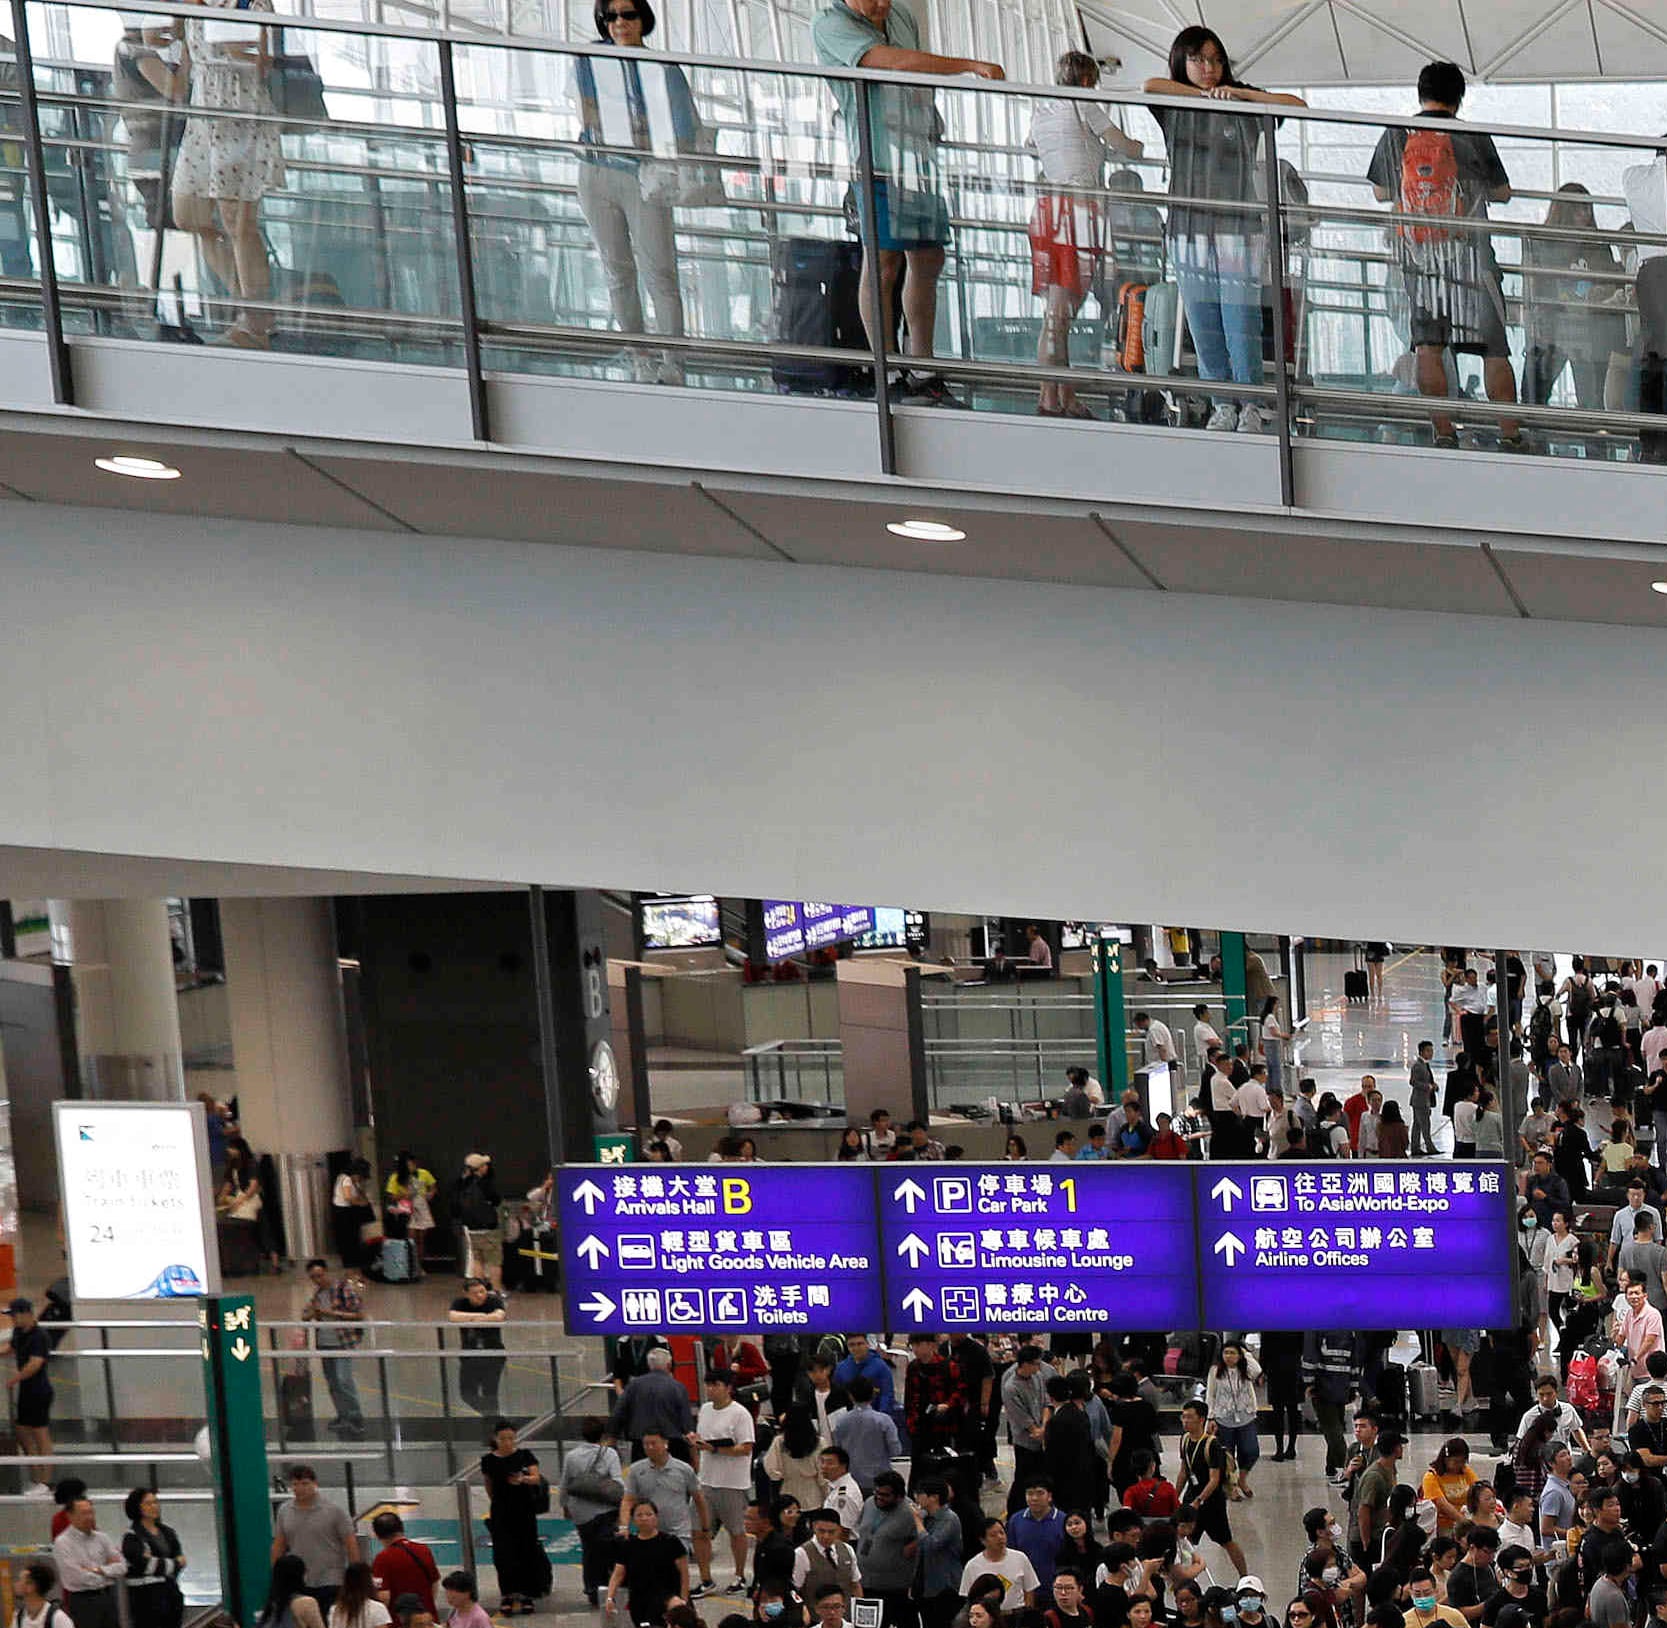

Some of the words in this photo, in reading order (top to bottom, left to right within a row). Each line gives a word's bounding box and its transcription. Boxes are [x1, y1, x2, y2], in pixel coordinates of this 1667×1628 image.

[613, 1175, 718, 1199] 接機大堂
[977, 1174, 1053, 1198] 停車場
[1294, 1172, 1499, 1196] 往亞洲國際博覽館
[615, 1200, 680, 1215] Arrivals
[683, 1199, 715, 1215] Hall
[722, 1178, 753, 1215] B
[978, 1198, 1007, 1213] Car
[1011, 1198, 1048, 1213] Park
[1060, 1179, 1076, 1212] 1
[1294, 1196, 1314, 1211] To
[1319, 1196, 1448, 1212] AsiaWorld-Expo
[89, 1223, 115, 1244] 24
[660, 1231, 792, 1253] 輕型貨車區
[980, 1228, 1111, 1251] 專車候車處
[1254, 1227, 1435, 1250] 航空公司辦公室
[661, 1254, 704, 1272] Light
[709, 1254, 764, 1270] Goods
[768, 1254, 826, 1270] Vehicle
[829, 1254, 868, 1269] Area
[981, 1252, 1066, 1269] Limousine
[1071, 1252, 1134, 1271] Lounge
[1255, 1251, 1308, 1267] Airline
[1313, 1251, 1369, 1267] Offices
[753, 1285, 830, 1309] 洗手間
[984, 1283, 1087, 1305] 醫療中心
[754, 1308, 808, 1325] Toilets
[986, 1306, 1049, 1322] Medical
[1054, 1306, 1109, 1322] Centre
